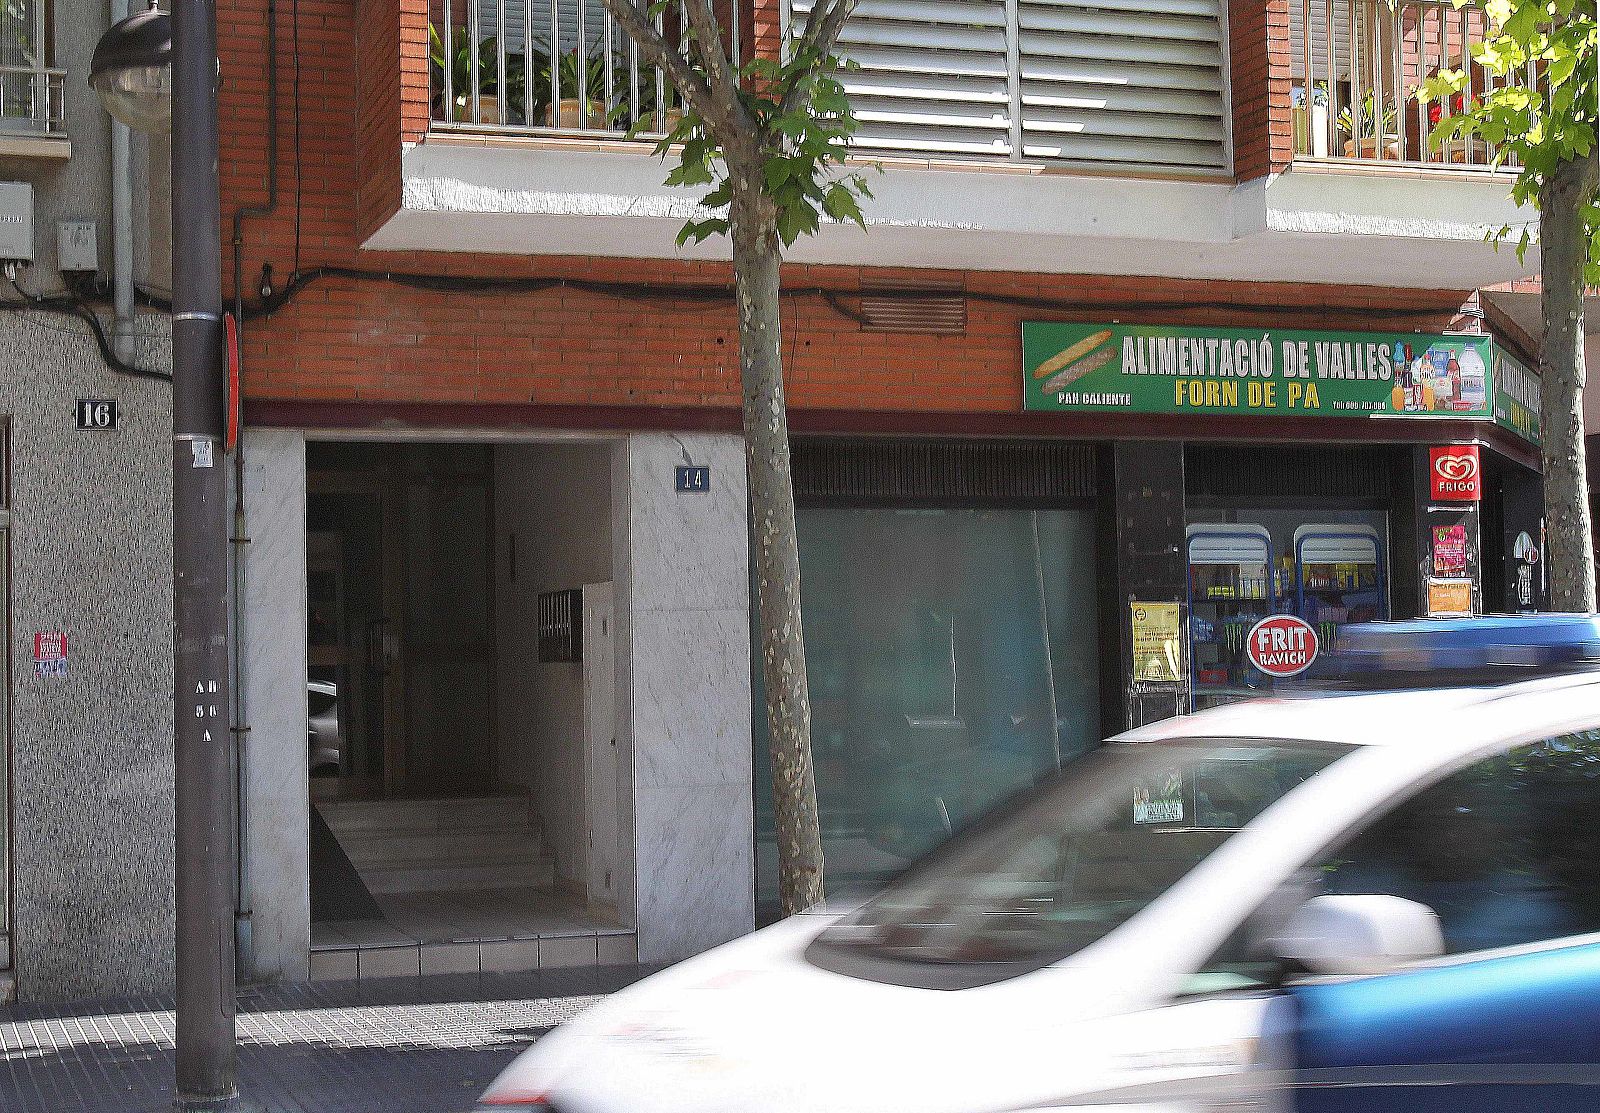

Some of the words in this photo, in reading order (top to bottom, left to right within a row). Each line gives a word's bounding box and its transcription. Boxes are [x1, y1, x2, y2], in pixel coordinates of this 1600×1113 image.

[1121, 332, 1273, 378] ALIMENTACIÓ
[1282, 340, 1310, 379] DE
[1315, 341, 1392, 381] VALLES
[1058, 391, 1079, 405] PAN
[1082, 392, 1132, 407] CALIENTE
[1175, 379, 1239, 407] FORN
[1247, 381, 1278, 408] DE
[1288, 382, 1320, 409] PA
[84, 402, 111, 427] 16
[684, 470, 702, 489] 14
[1438, 481, 1476, 493] FRIGO
[1257, 626, 1308, 652] FRIT
[1259, 651, 1307, 666] RAVICH
[203, 729, 212, 742] A
